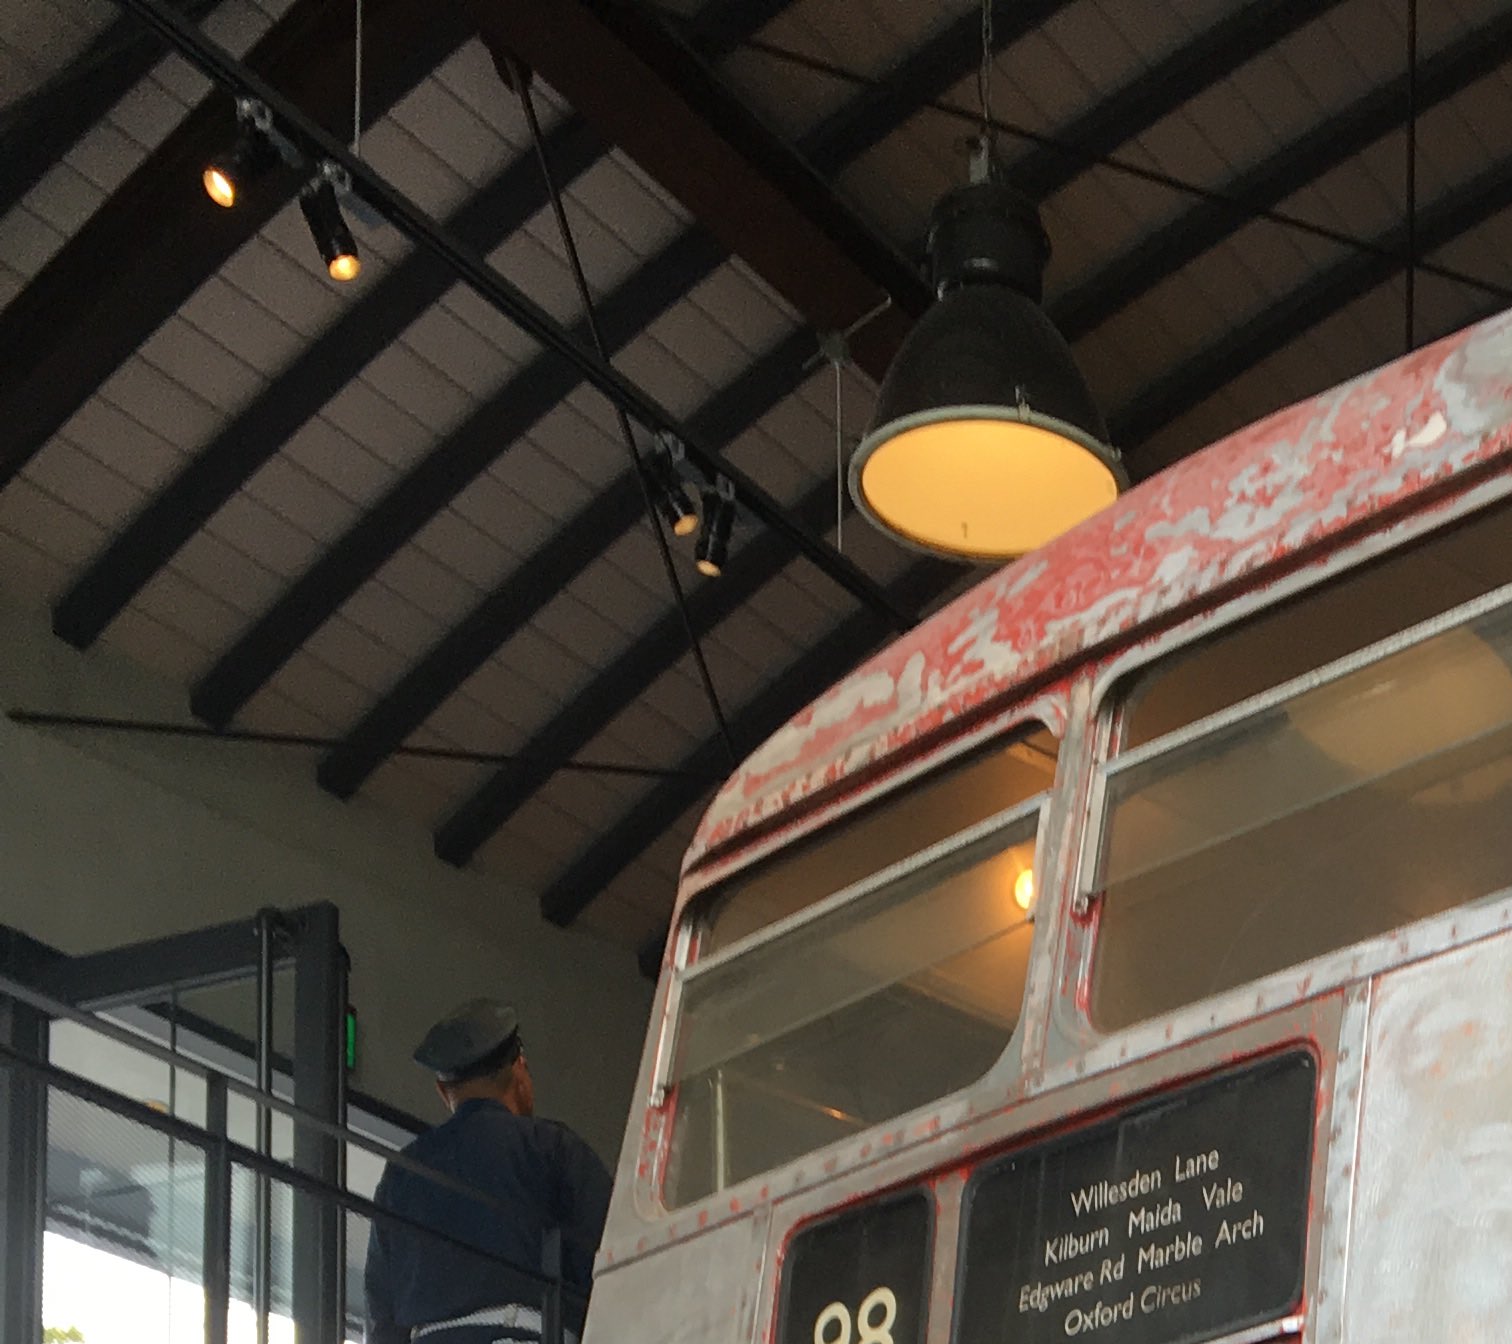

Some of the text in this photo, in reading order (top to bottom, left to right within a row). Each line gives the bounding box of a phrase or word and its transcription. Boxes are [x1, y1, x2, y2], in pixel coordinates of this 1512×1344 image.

[1044, 1177, 1243, 1267] Kilburn Maida Vale
[1071, 1149, 1220, 1217] Willesden Lane
[1018, 1209, 1264, 1313] Edgware Rd Marble Arch
[1064, 1278, 1202, 1336] Oxford Circus
